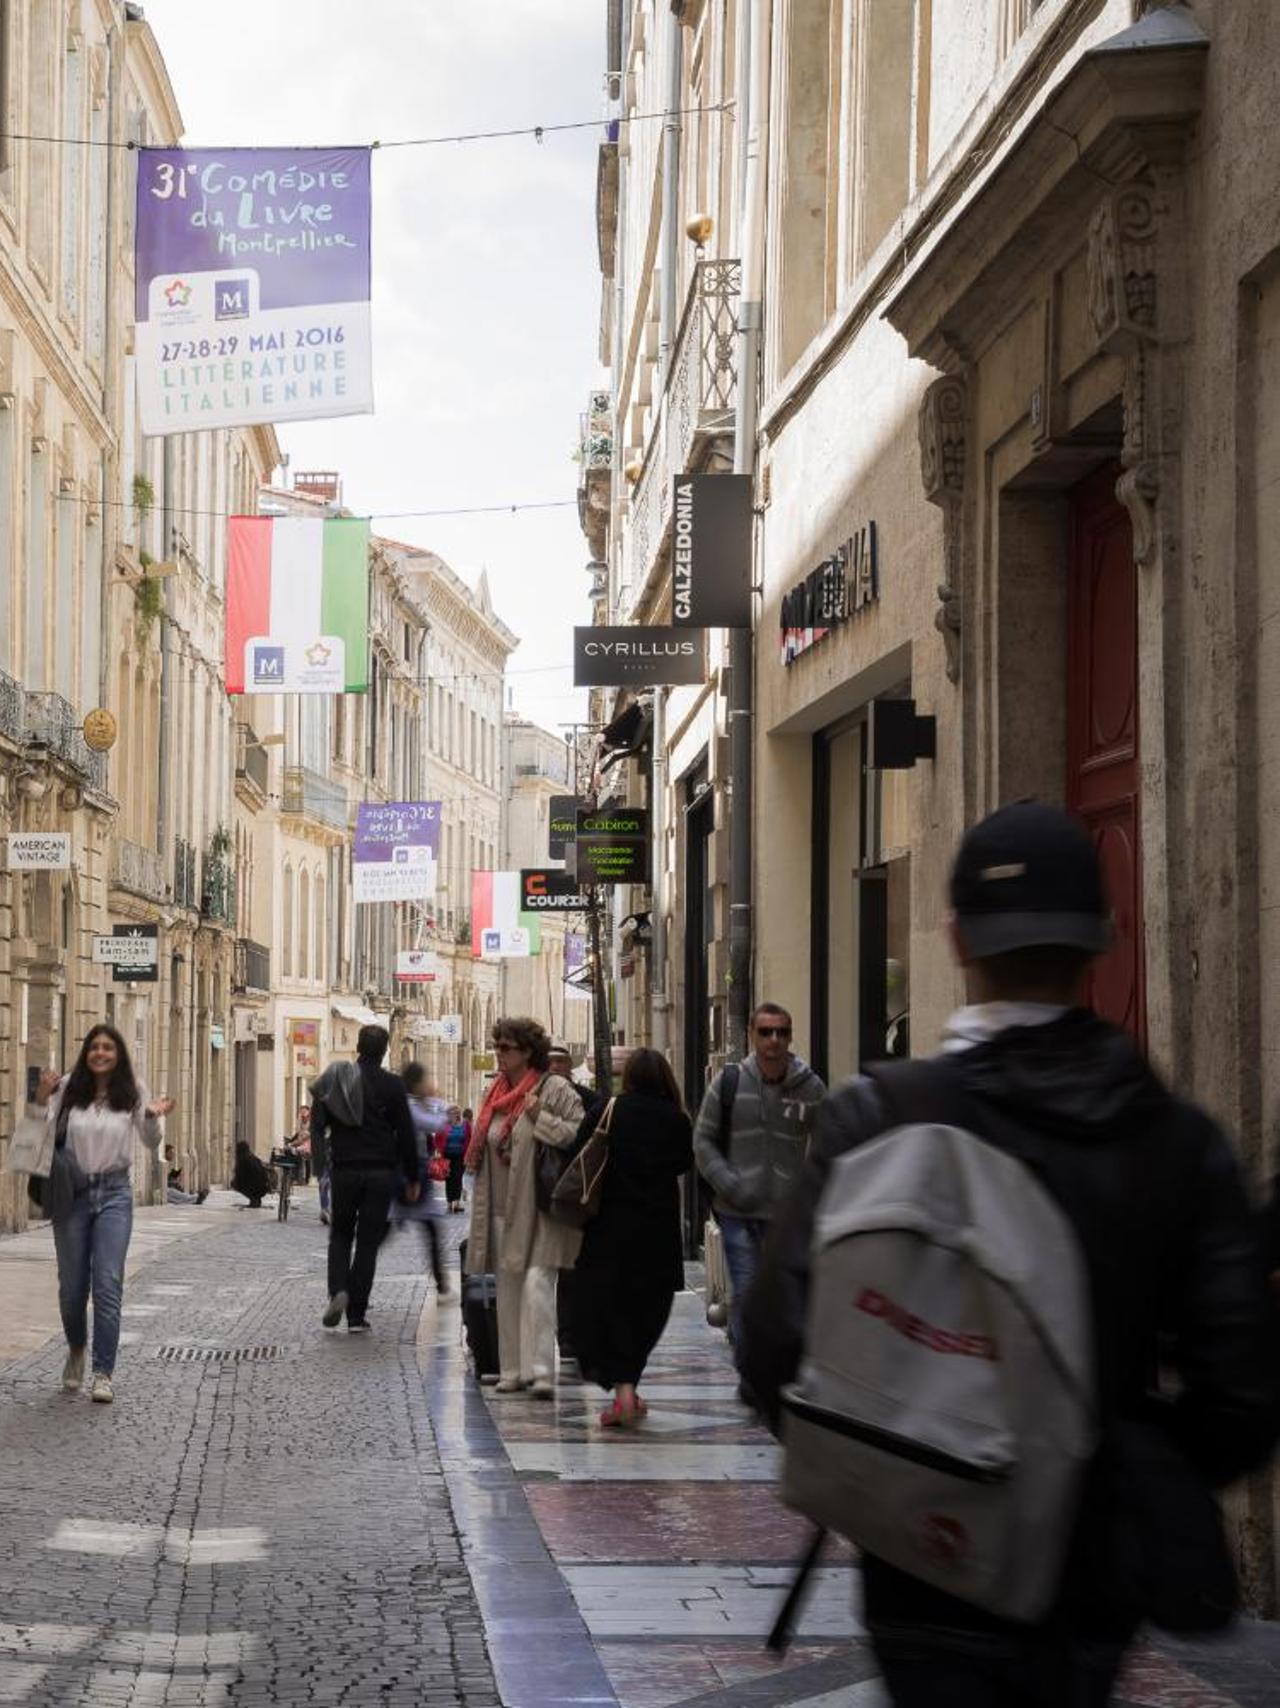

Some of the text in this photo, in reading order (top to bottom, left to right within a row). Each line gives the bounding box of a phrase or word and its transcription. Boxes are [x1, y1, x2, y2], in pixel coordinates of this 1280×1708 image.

[190, 195, 224, 228] du
[222, 290, 243, 310] M
[249, 331, 285, 353] MAI
[296, 326, 345, 348] 2016
[162, 350, 347, 389] LITTÉRATURE
[164, 375, 347, 415] ITALIENNE
[675, 483, 693, 619] CALZEDONIA
[584, 642, 695, 656] CYRILLUS
[12, 840, 66, 850] AMERICAN
[16, 851, 60, 863] VINTAGE
[526, 873, 548, 894] C
[854, 1285, 1001, 1361] DIESEL
